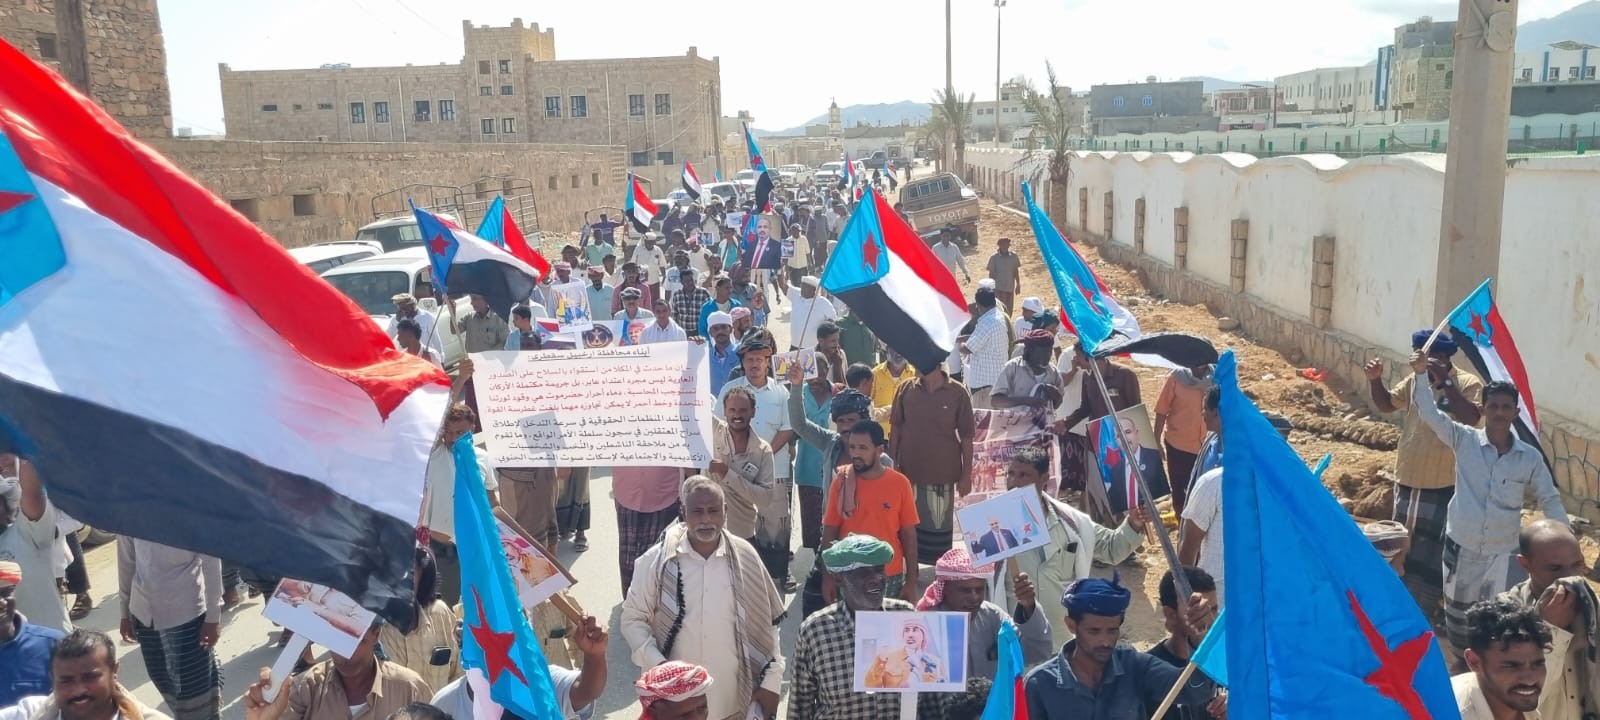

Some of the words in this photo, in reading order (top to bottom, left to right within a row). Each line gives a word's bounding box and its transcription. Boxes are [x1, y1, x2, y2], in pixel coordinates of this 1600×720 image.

[928, 208, 969, 223] TOYOTA
[597, 348, 631, 357] محافظة
[632, 346, 650, 356] أبناء
[536, 367, 567, 379] بالسلاح
[600, 367, 612, 375] من
[613, 364, 632, 372] المكلا
[633, 365, 641, 375] في
[487, 370, 517, 380] الصدور
[648, 375, 666, 385] ليس
[668, 375, 693, 385] العارية
[489, 381, 514, 391] الأركان
[516, 380, 543, 389] مكتملة
[545, 381, 569, 389] جريمة
[571, 379, 580, 387] بل
[626, 377, 647, 385] مجرد
[545, 391, 584, 400] حضرموت
[585, 387, 605, 399] أحرار
[606, 388, 622, 396] دماء
[488, 395, 511, 403] ثورتنا
[512, 393, 530, 402] وقود
[538, 404, 560, 412] بلغت
[560, 403, 578, 411] مهما
[580, 401, 601, 411] تجاوزه
[632, 398, 651, 409] أحمر
[654, 400, 672, 409] وخط
[487, 406, 506, 414] القوة
[508, 405, 537, 413] غطرسة
[522, 419, 551, 429] التدخل
[553, 418, 577, 428] سرعة
[578, 416, 586, 427] في
[588, 416, 626, 427] الحقوقية
[559, 430, 576, 440] الأمر
[604, 429, 632, 438] سجون
[633, 428, 641, 438] في
[643, 427, 678, 437] المعتقلين
[679, 428, 700, 439] سراح
[508, 442, 560, 451] والشخصيات
[596, 440, 635, 450] الناشطين
[636, 439, 666, 448] ملاحقة
[681, 441, 690, 450] به
[527, 453, 558, 462] الشعب
[560, 454, 584, 462] صوت
[586, 453, 618, 463] لإسكات
[620, 452, 667, 462] والاجتماعية
[668, 452, 706, 462] الأكاديمية
